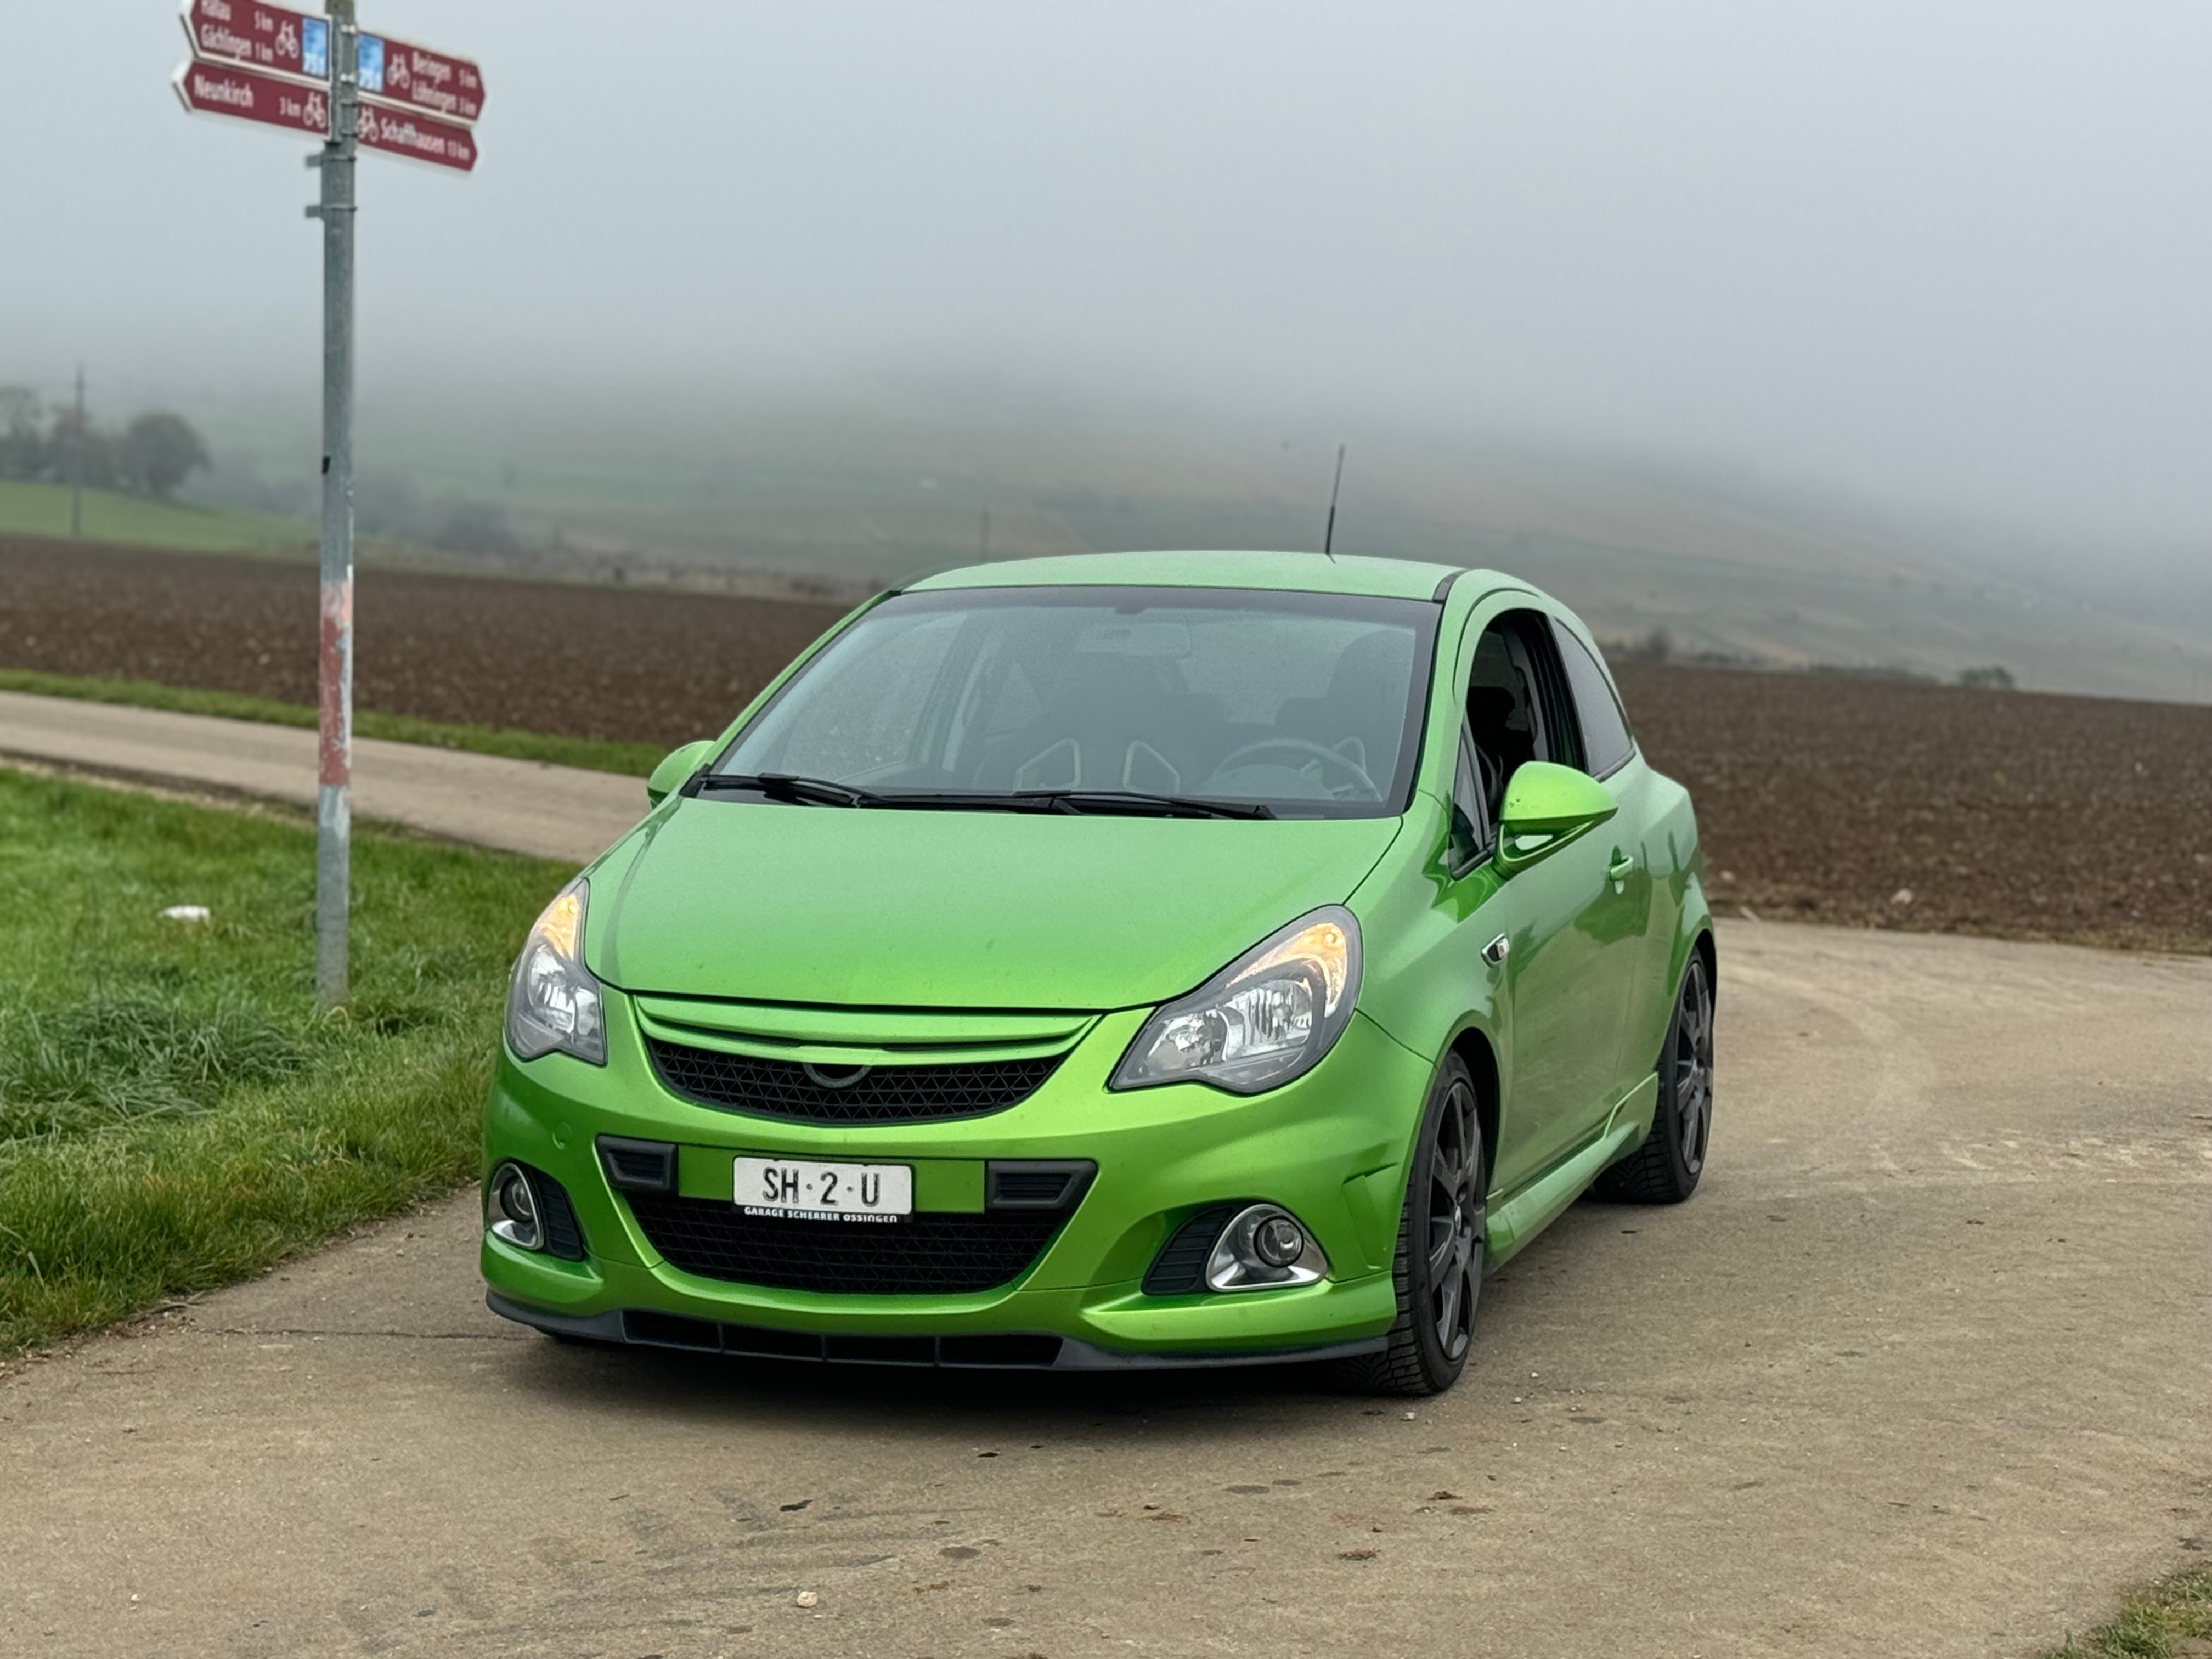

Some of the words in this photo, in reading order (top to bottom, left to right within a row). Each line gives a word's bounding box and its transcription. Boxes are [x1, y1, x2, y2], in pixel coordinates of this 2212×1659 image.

[261, 11, 273, 32] km
[261, 43, 273, 62] km
[465, 69, 477, 88] km
[194, 74, 254, 108] Neunkirch
[286, 98, 301, 118] km
[465, 98, 477, 116] km
[380, 117, 445, 155] Schaffhausen
[458, 143, 470, 160] km
[744, 1206, 784, 1218] GARAGE
[787, 1210, 840, 1221] SCHERRER
